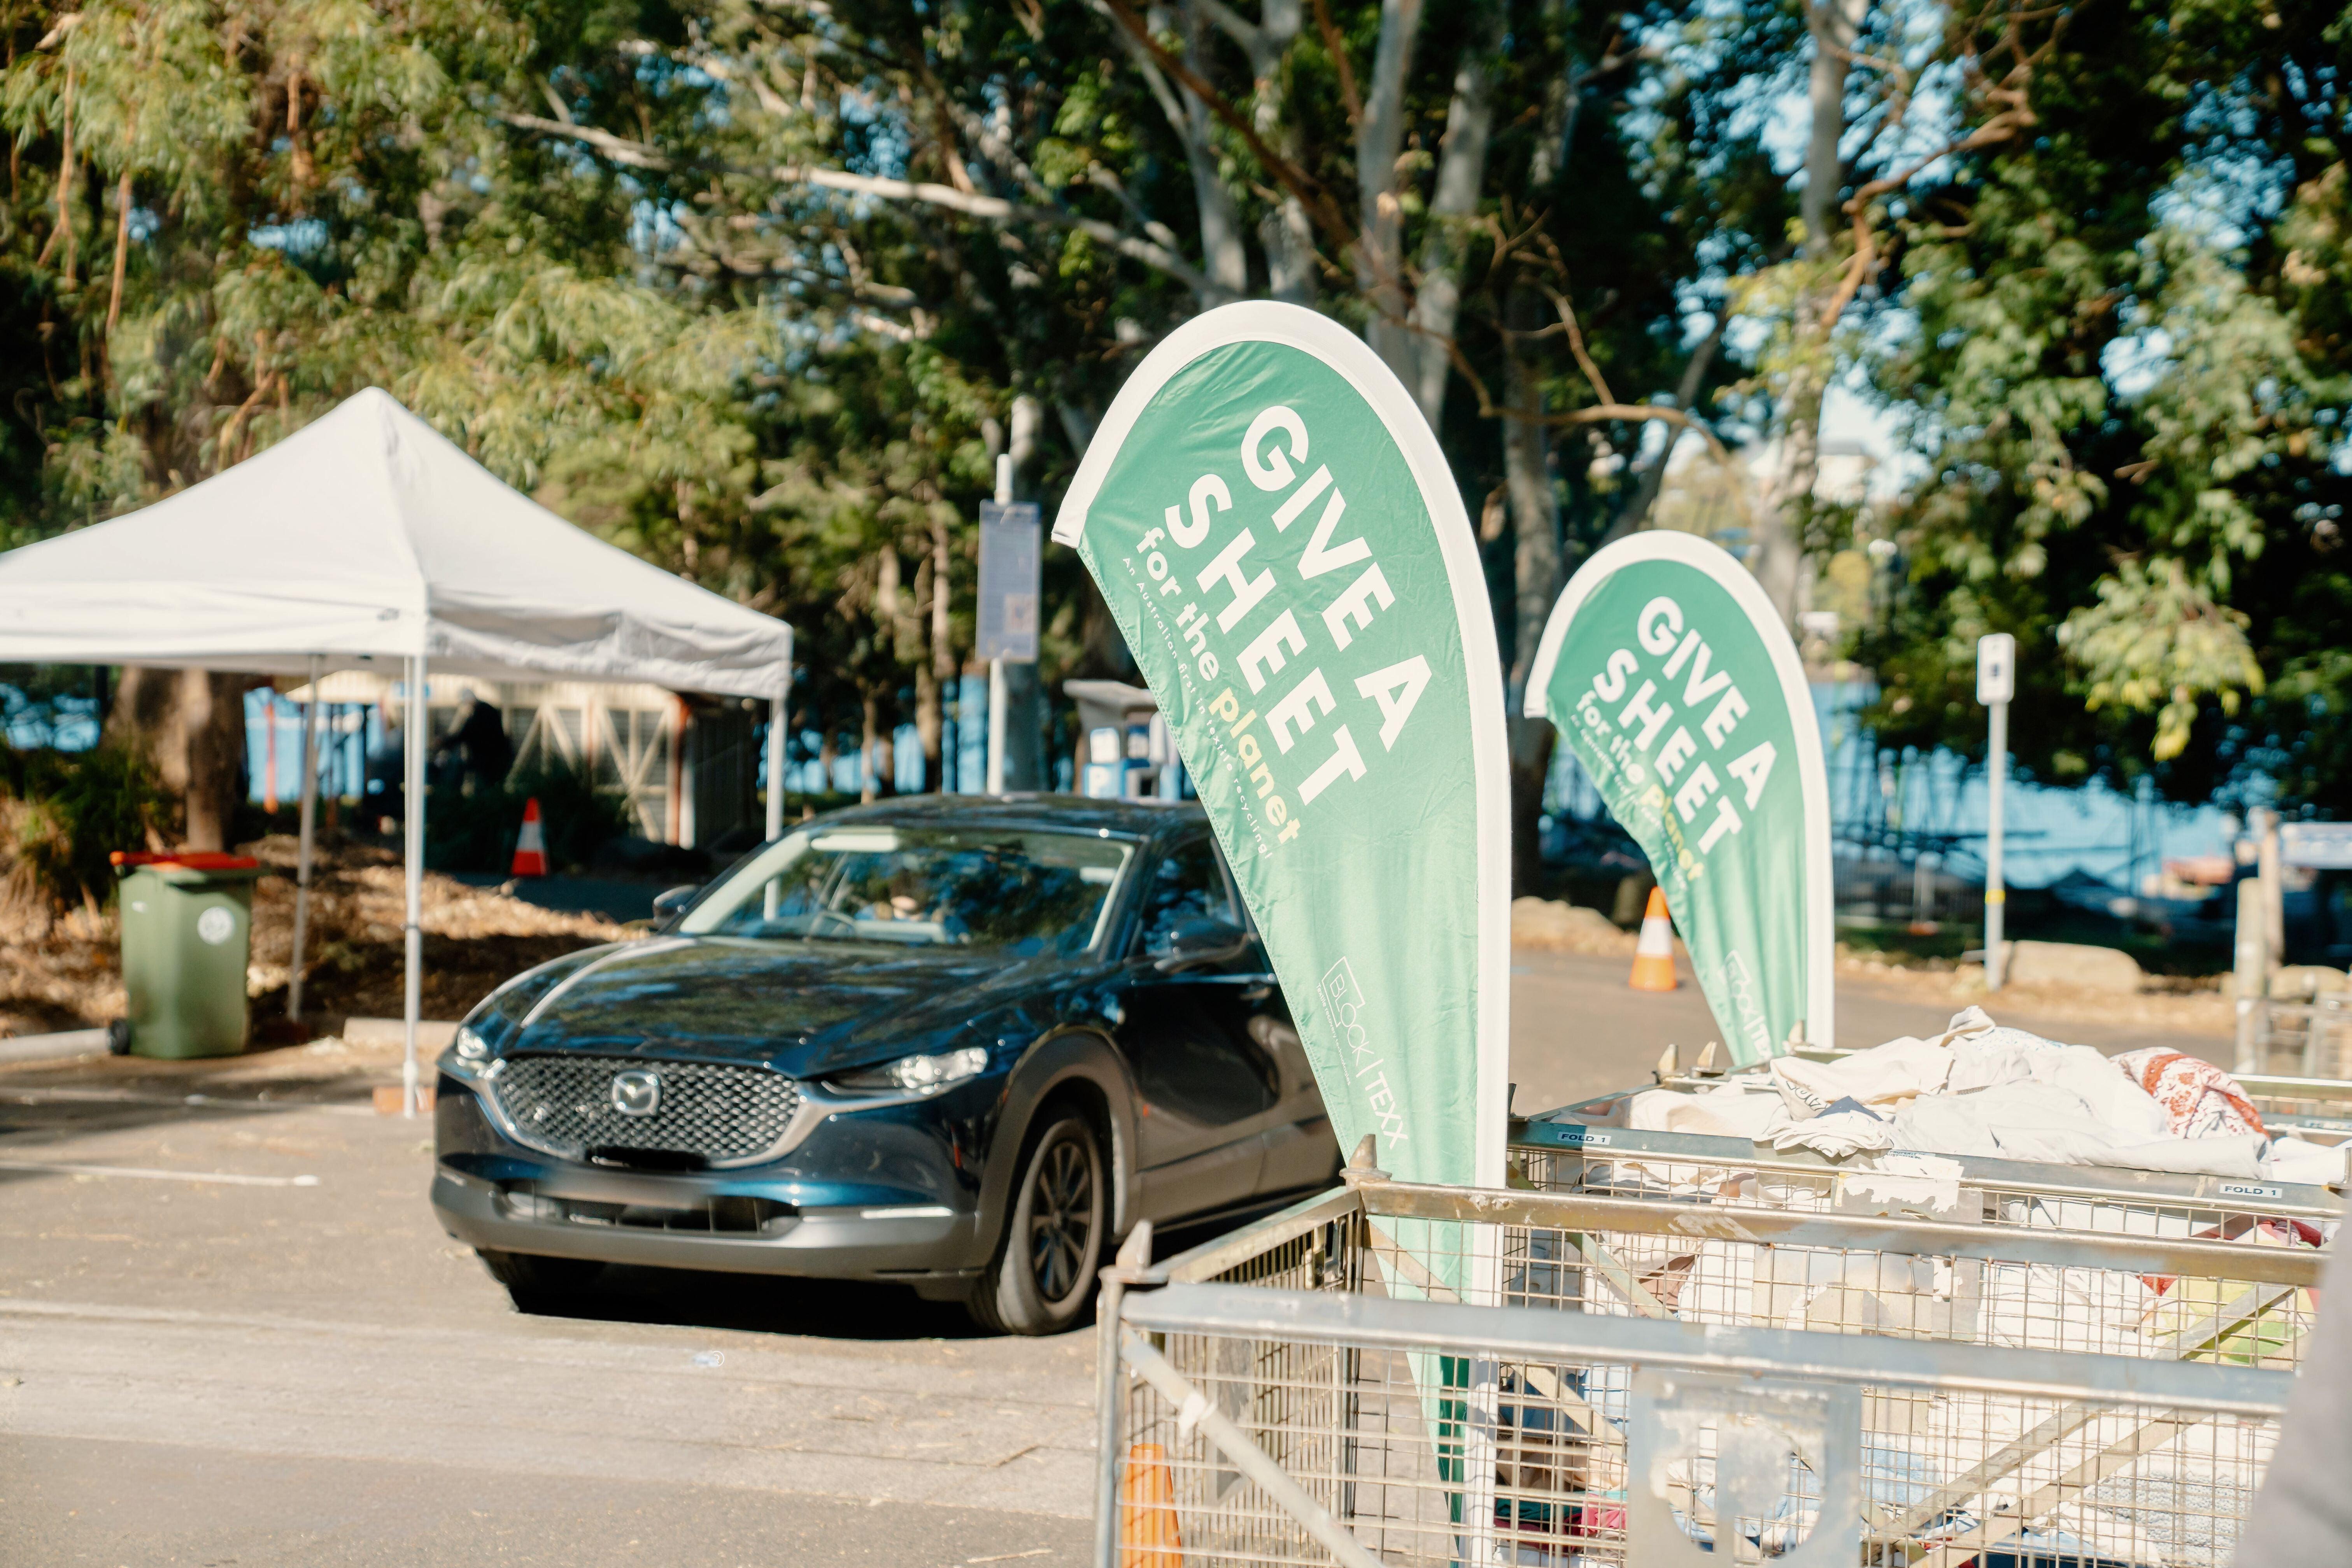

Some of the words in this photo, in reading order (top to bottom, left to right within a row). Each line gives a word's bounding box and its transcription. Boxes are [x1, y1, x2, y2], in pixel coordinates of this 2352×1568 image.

[1165, 473, 1367, 806] SHEET
[1241, 405, 1395, 652] GIVE
[1354, 654, 1433, 753] A
[1123, 557, 1135, 576] An
[1136, 582, 1177, 659] Australian
[1178, 663, 1196, 694] first
[1195, 697, 1206, 715] in
[1206, 719, 1232, 772] textile
[1233, 778, 1273, 859] recycling!
[1136, 527, 1182, 597] for
[1176, 601, 1219, 681] the
[1208, 687, 1301, 844] planet
[1576, 690, 1612, 736] for
[1593, 648, 1742, 855] SHEET
[1636, 596, 1750, 750] GIVE
[1726, 740, 1777, 811] A
[1316, 983, 1327, 1010] Textile
[1325, 1007, 1337, 1038] recovery
[1335, 1038, 1351, 1086] technologies
[1329, 973, 1374, 1067] BLOCK
[1365, 1071, 1409, 1150] TEXX
[2224, 1186, 2263, 1194] FOLD
